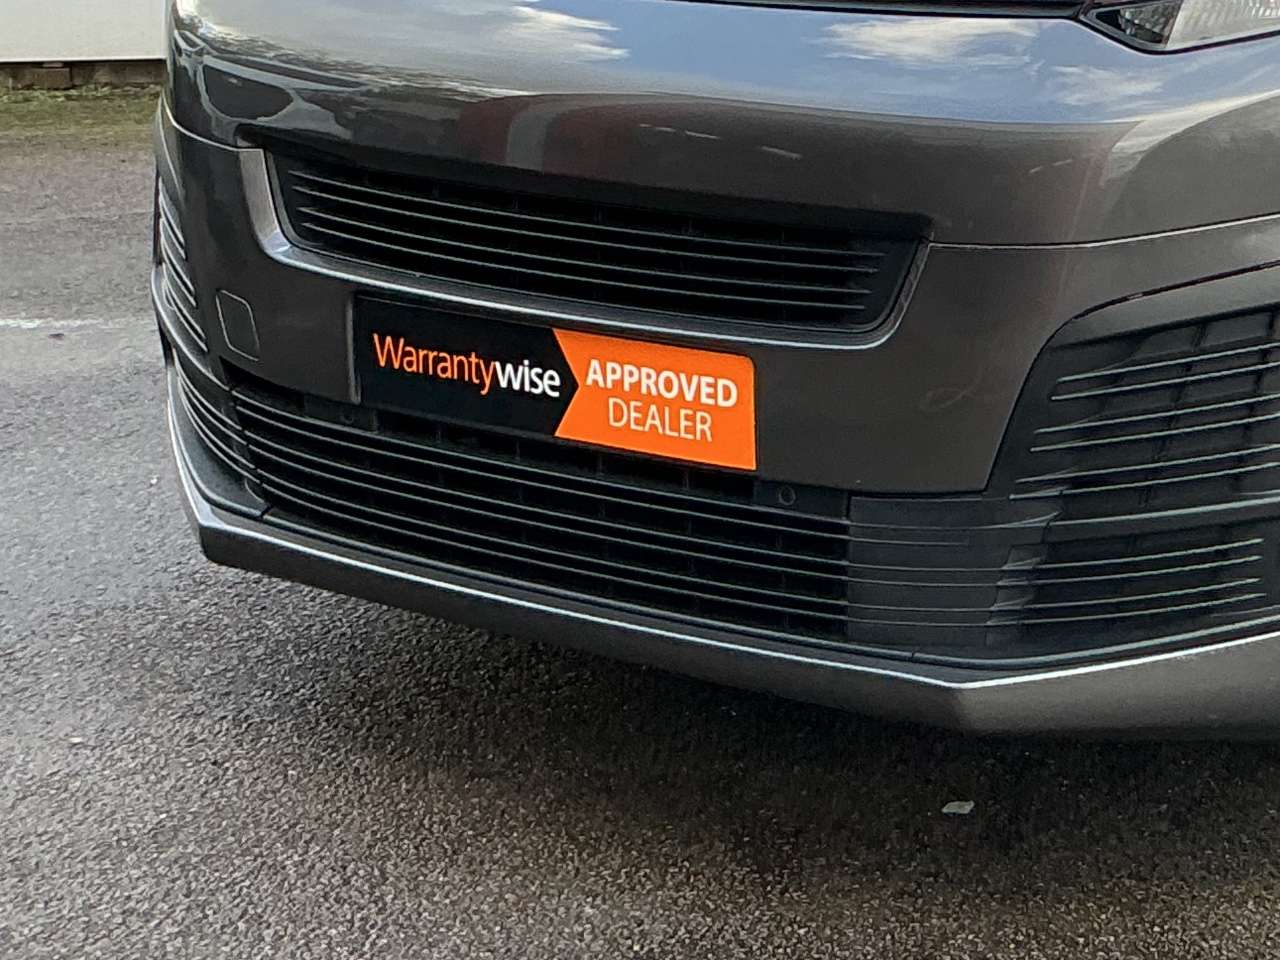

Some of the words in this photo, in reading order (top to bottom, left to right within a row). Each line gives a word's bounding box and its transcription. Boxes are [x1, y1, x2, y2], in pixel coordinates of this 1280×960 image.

[372, 333, 561, 397] Warrantywise
[586, 359, 738, 407] APPROVED
[608, 397, 713, 442] DEALER
